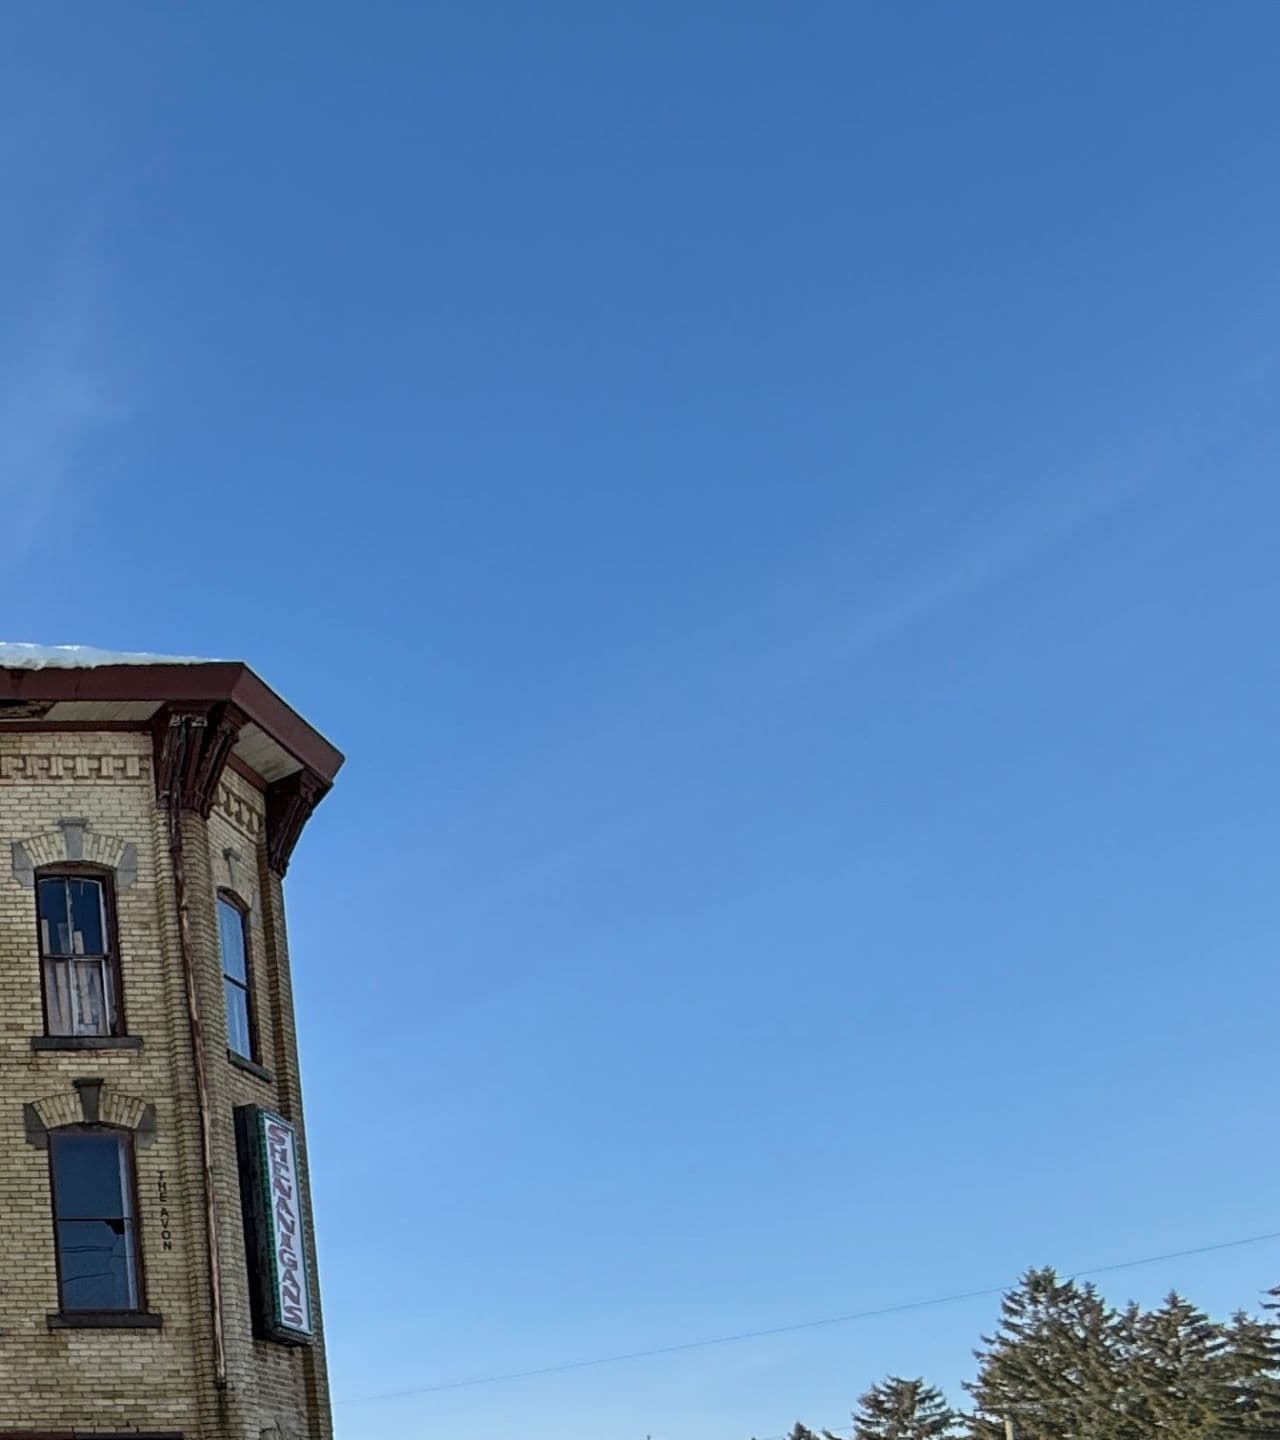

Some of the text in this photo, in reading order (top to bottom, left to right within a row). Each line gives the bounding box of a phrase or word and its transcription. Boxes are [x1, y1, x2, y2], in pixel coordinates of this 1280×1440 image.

[157, 1170, 172, 1250] THE AVON
[268, 1124, 303, 1327] SHENANIGANS
